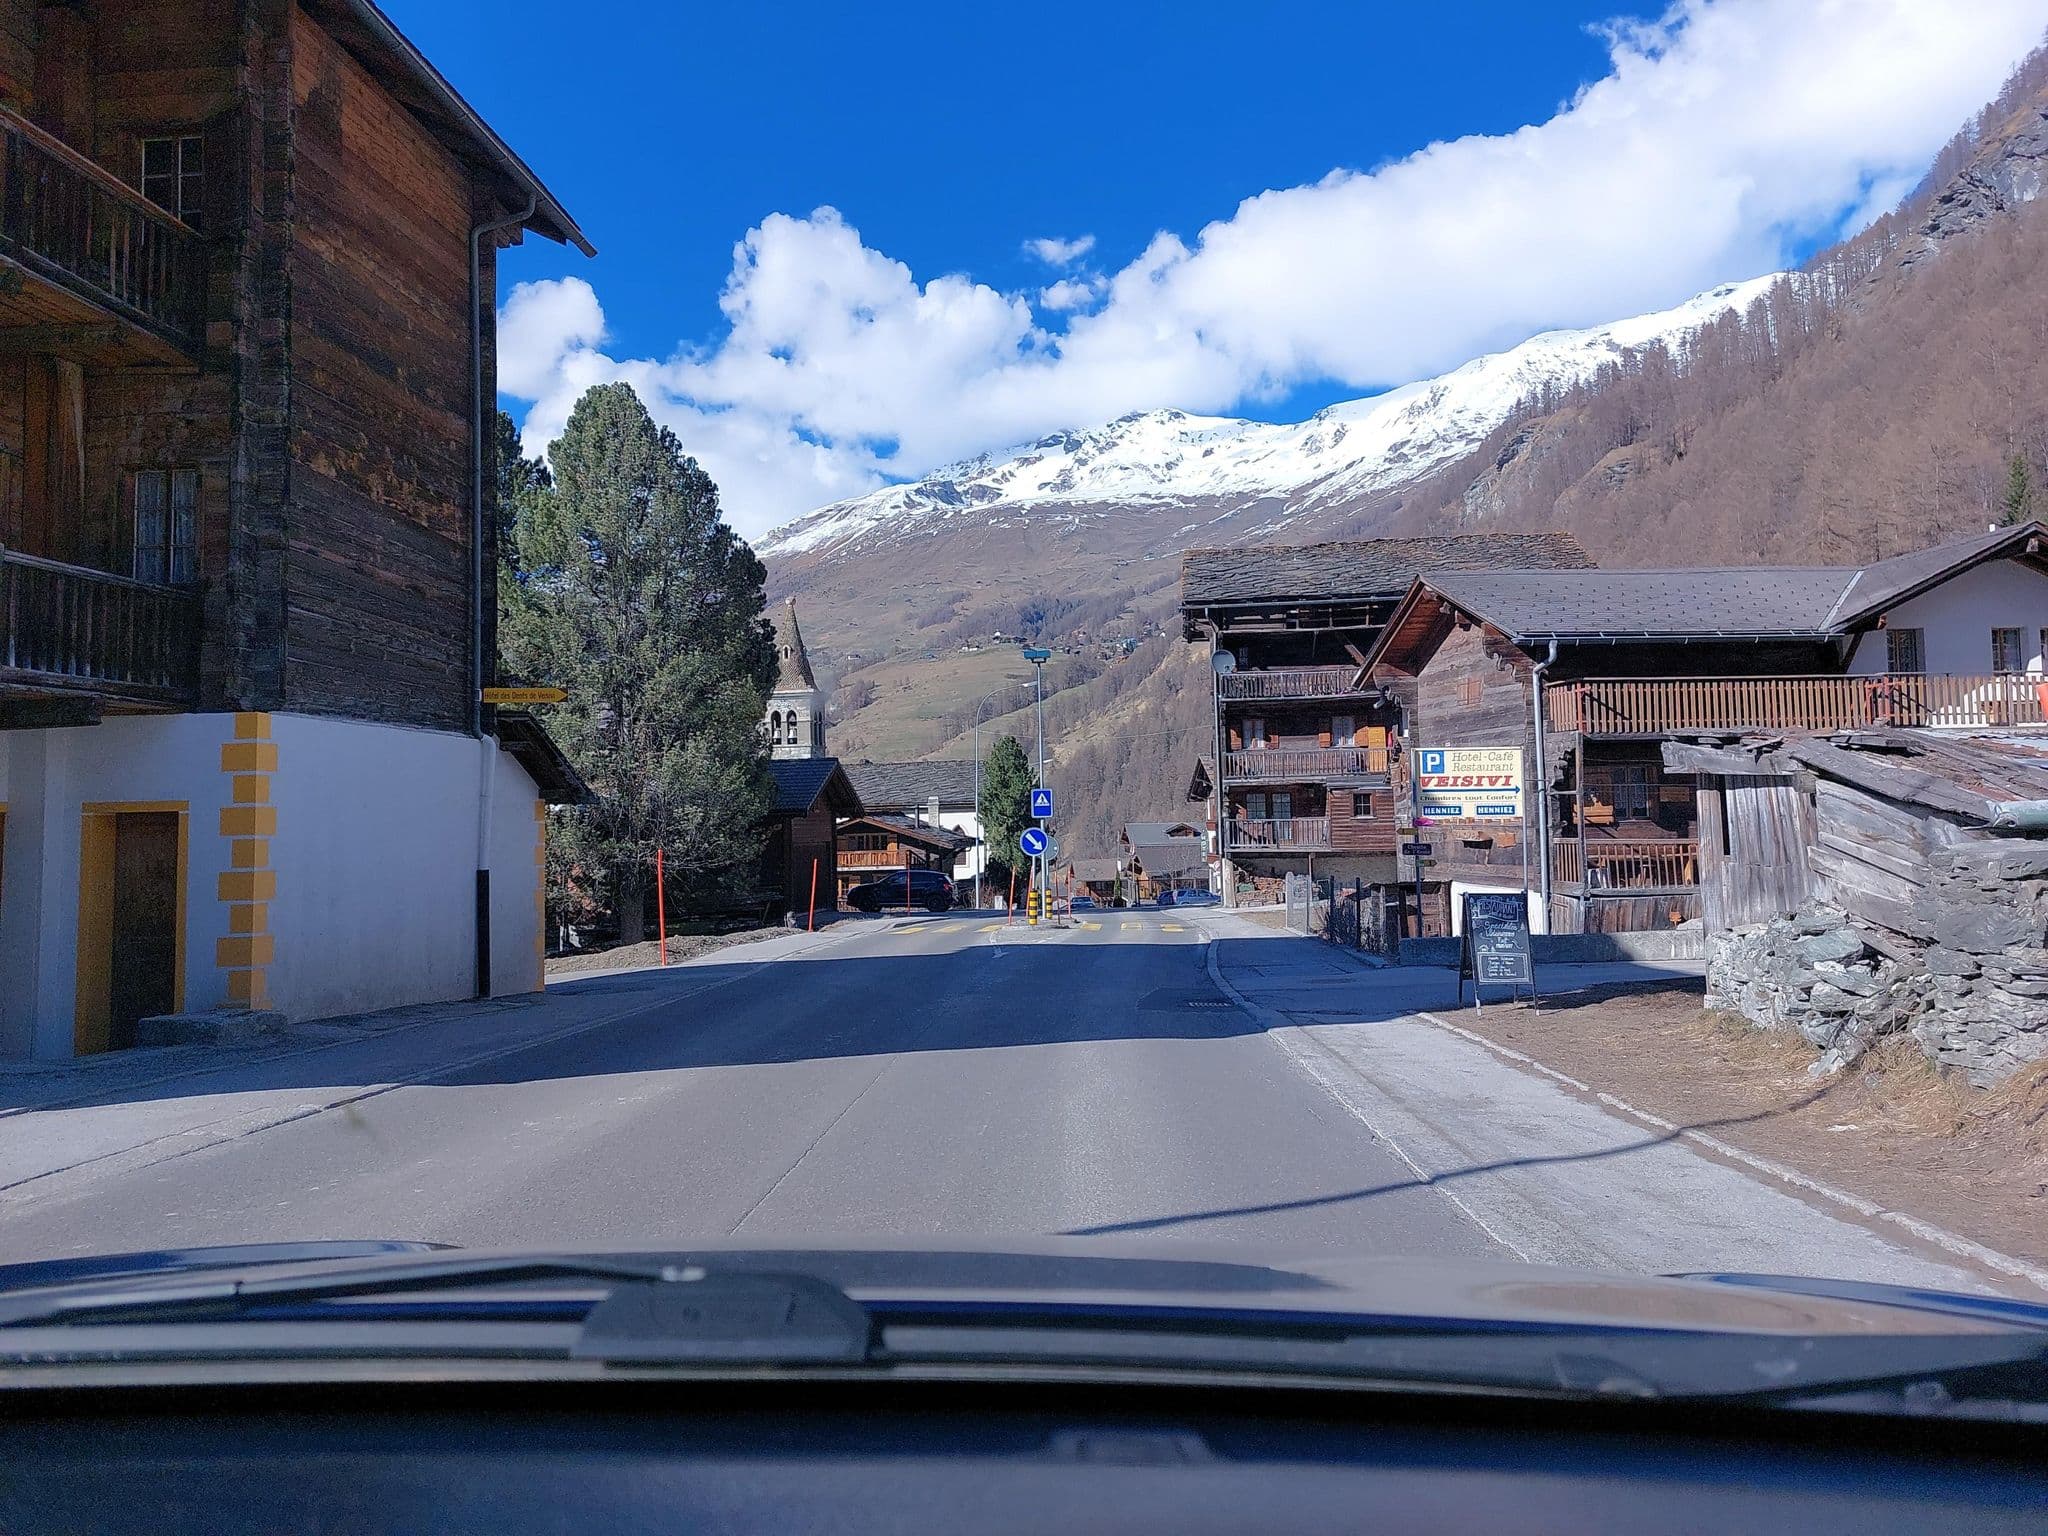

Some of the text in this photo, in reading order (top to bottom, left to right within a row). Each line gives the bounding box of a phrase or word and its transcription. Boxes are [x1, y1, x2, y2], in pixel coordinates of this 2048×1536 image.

[1426, 753, 1441, 772] P
[1452, 762, 1514, 772] Restaurant
[1419, 775, 1514, 787] VEISIVI
[1424, 807, 1461, 815] HENNIEZ
[1477, 806, 1514, 814] HENNIEZ
